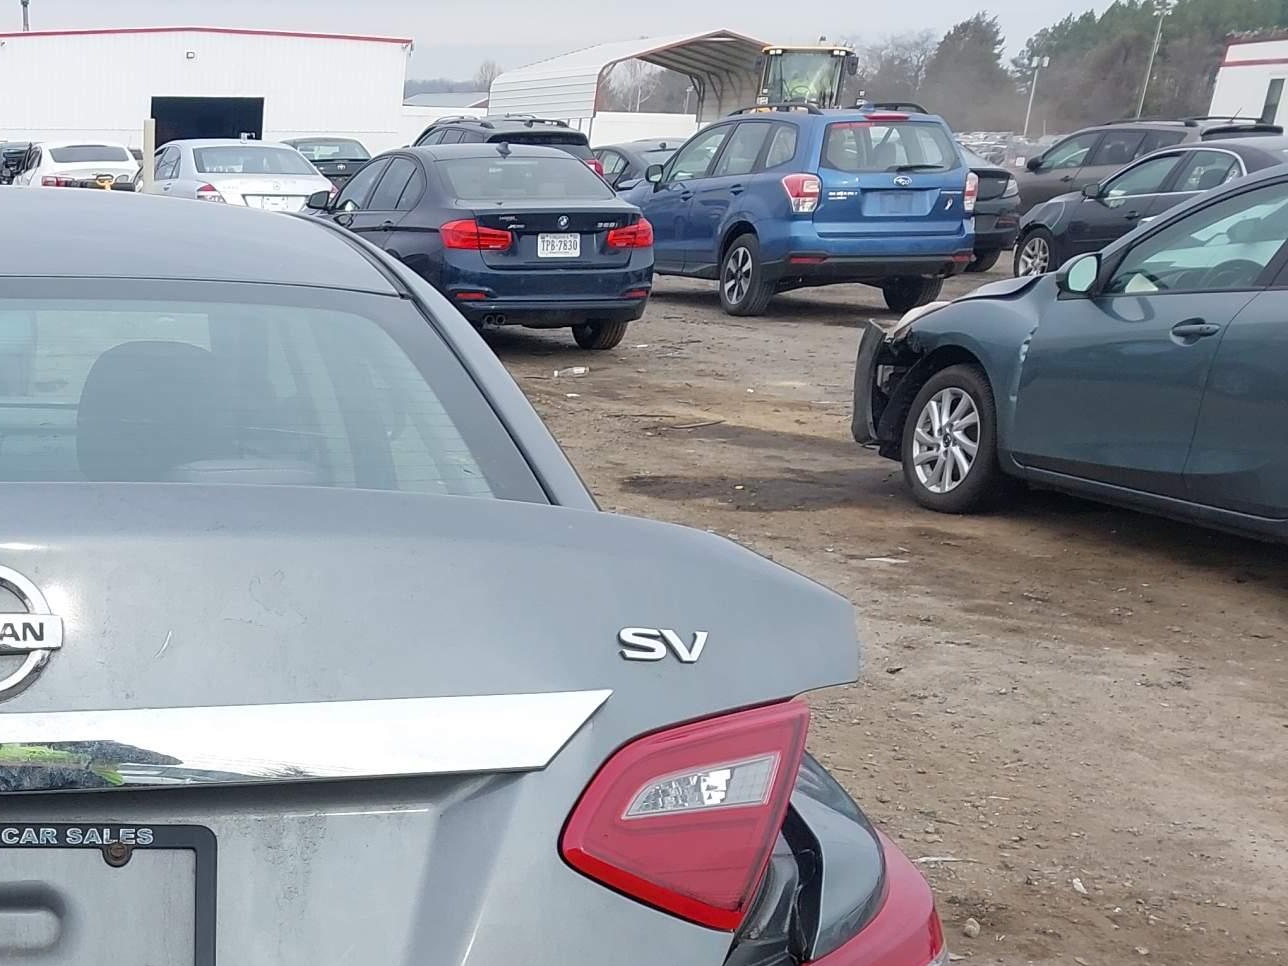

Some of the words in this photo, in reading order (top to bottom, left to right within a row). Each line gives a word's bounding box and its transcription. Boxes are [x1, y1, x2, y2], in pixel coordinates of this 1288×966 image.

[617, 627, 709, 664] SV
[1, 828, 57, 845] CAR
[66, 828, 154, 845] SALES
